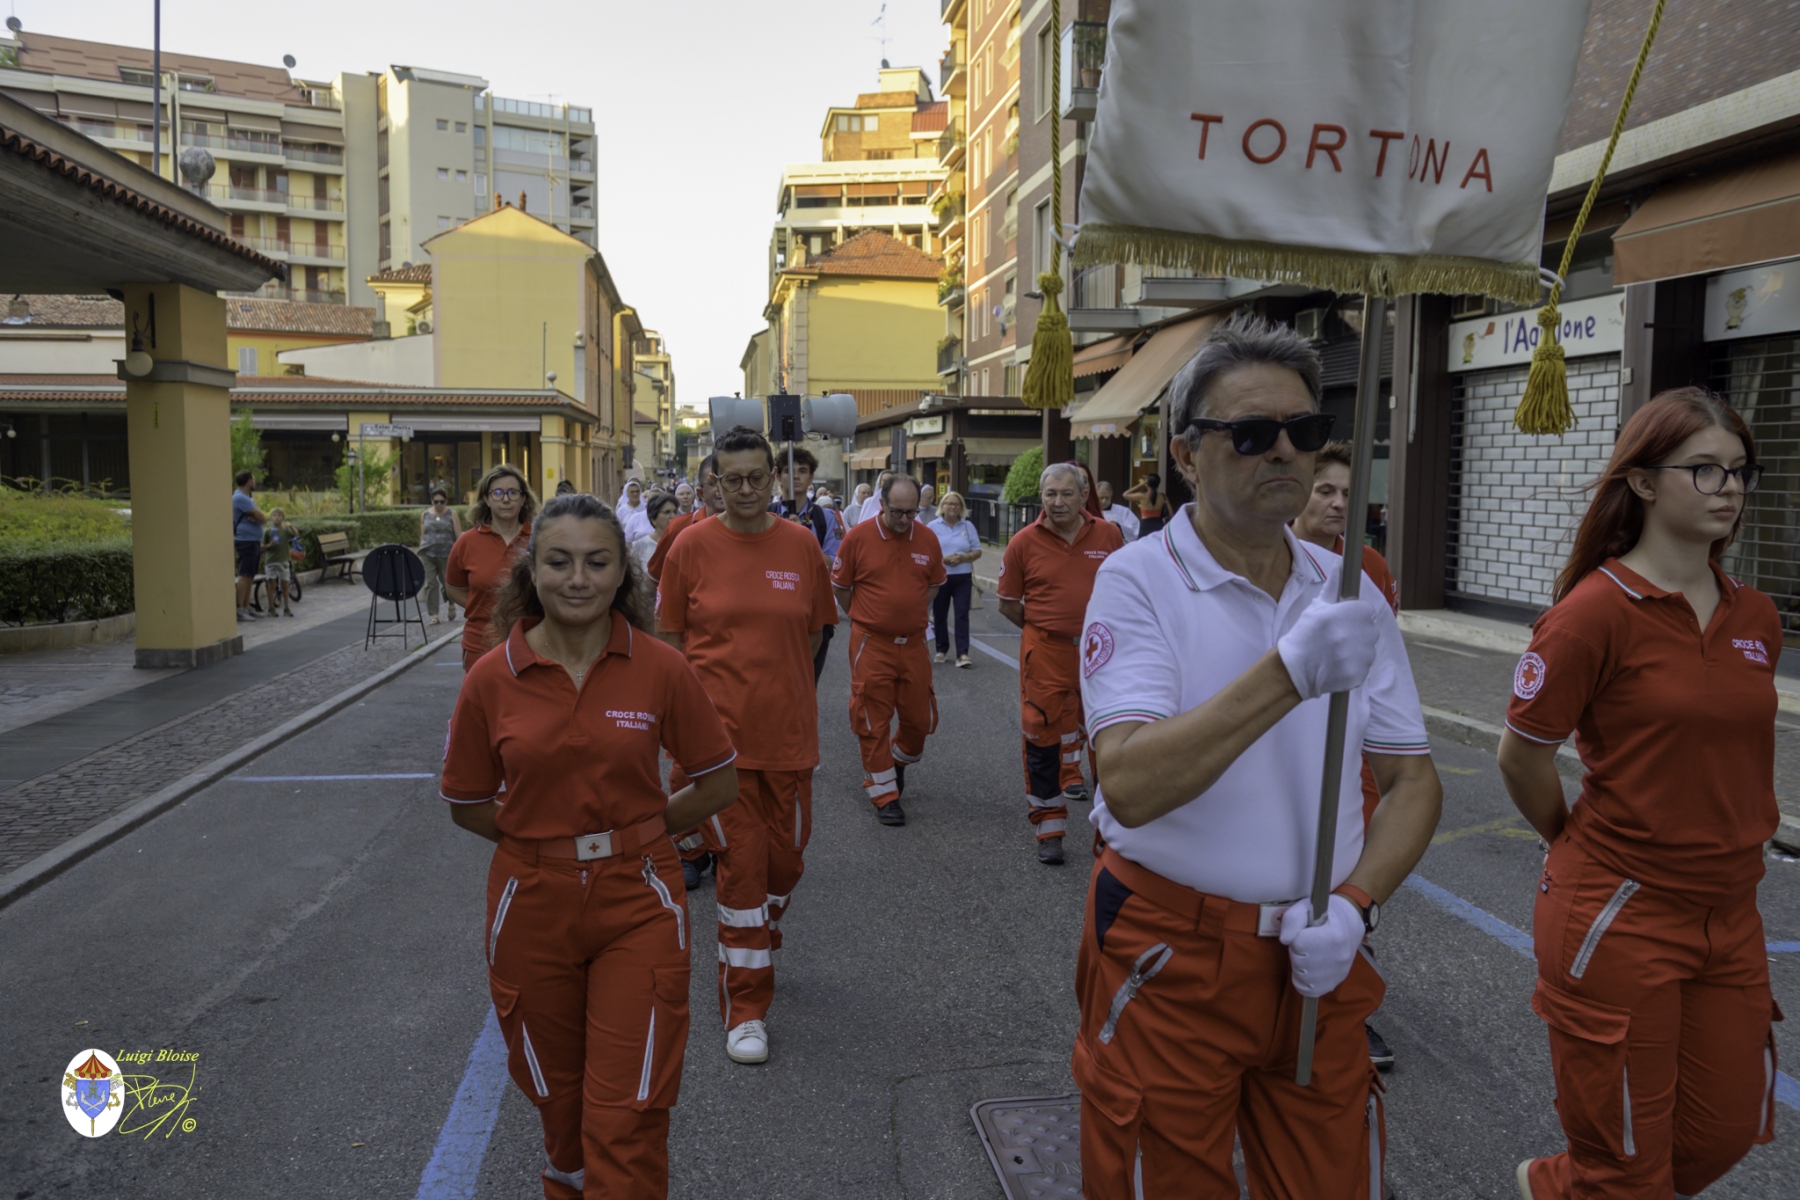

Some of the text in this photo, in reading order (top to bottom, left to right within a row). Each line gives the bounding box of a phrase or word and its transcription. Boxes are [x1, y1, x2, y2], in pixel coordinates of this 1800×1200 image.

[1191, 112, 1493, 193] TORTONA
[765, 570, 800, 582] CROCE ROSSA
[772, 580, 796, 590] ITALIANA
[1731, 638, 1755, 650] CROCE
[605, 710, 636, 718] CROCE
[616, 720, 649, 730] ITALIANA
